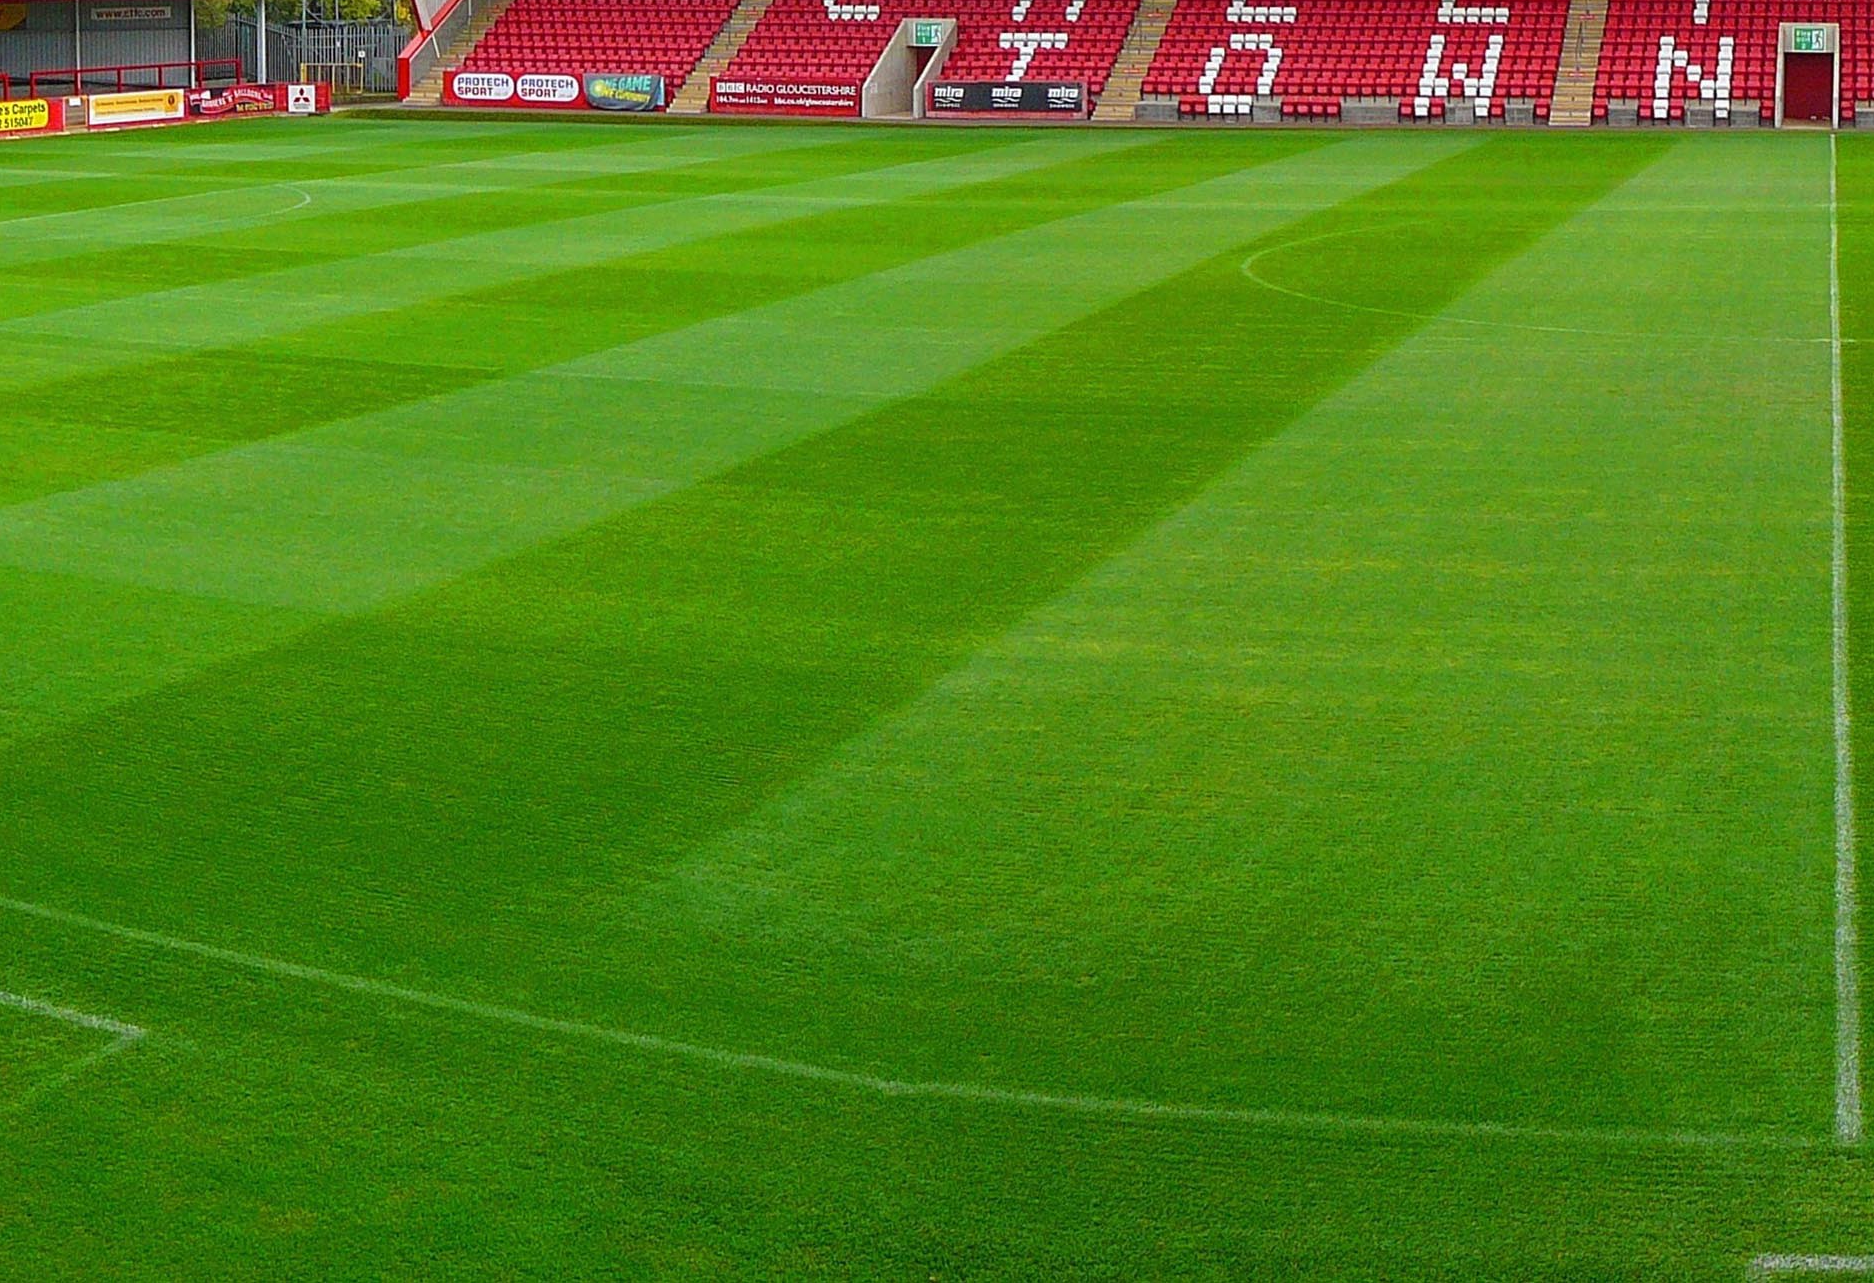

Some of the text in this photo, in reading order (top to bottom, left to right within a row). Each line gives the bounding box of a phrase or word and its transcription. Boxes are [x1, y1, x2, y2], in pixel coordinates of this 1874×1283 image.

[458, 77, 509, 87] PROTECH
[521, 79, 573, 88] PROTECH
[619, 76, 651, 91] GAME
[458, 87, 493, 96] SPORT
[521, 88, 557, 98] SPORT
[716, 82, 856, 95] BBC RADIO GLOUCESTERSHIRE
[934, 86, 964, 97] mira
[991, 86, 1022, 97] mira
[1047, 86, 1078, 98] mira
[12, 103, 46, 116] Carpets
